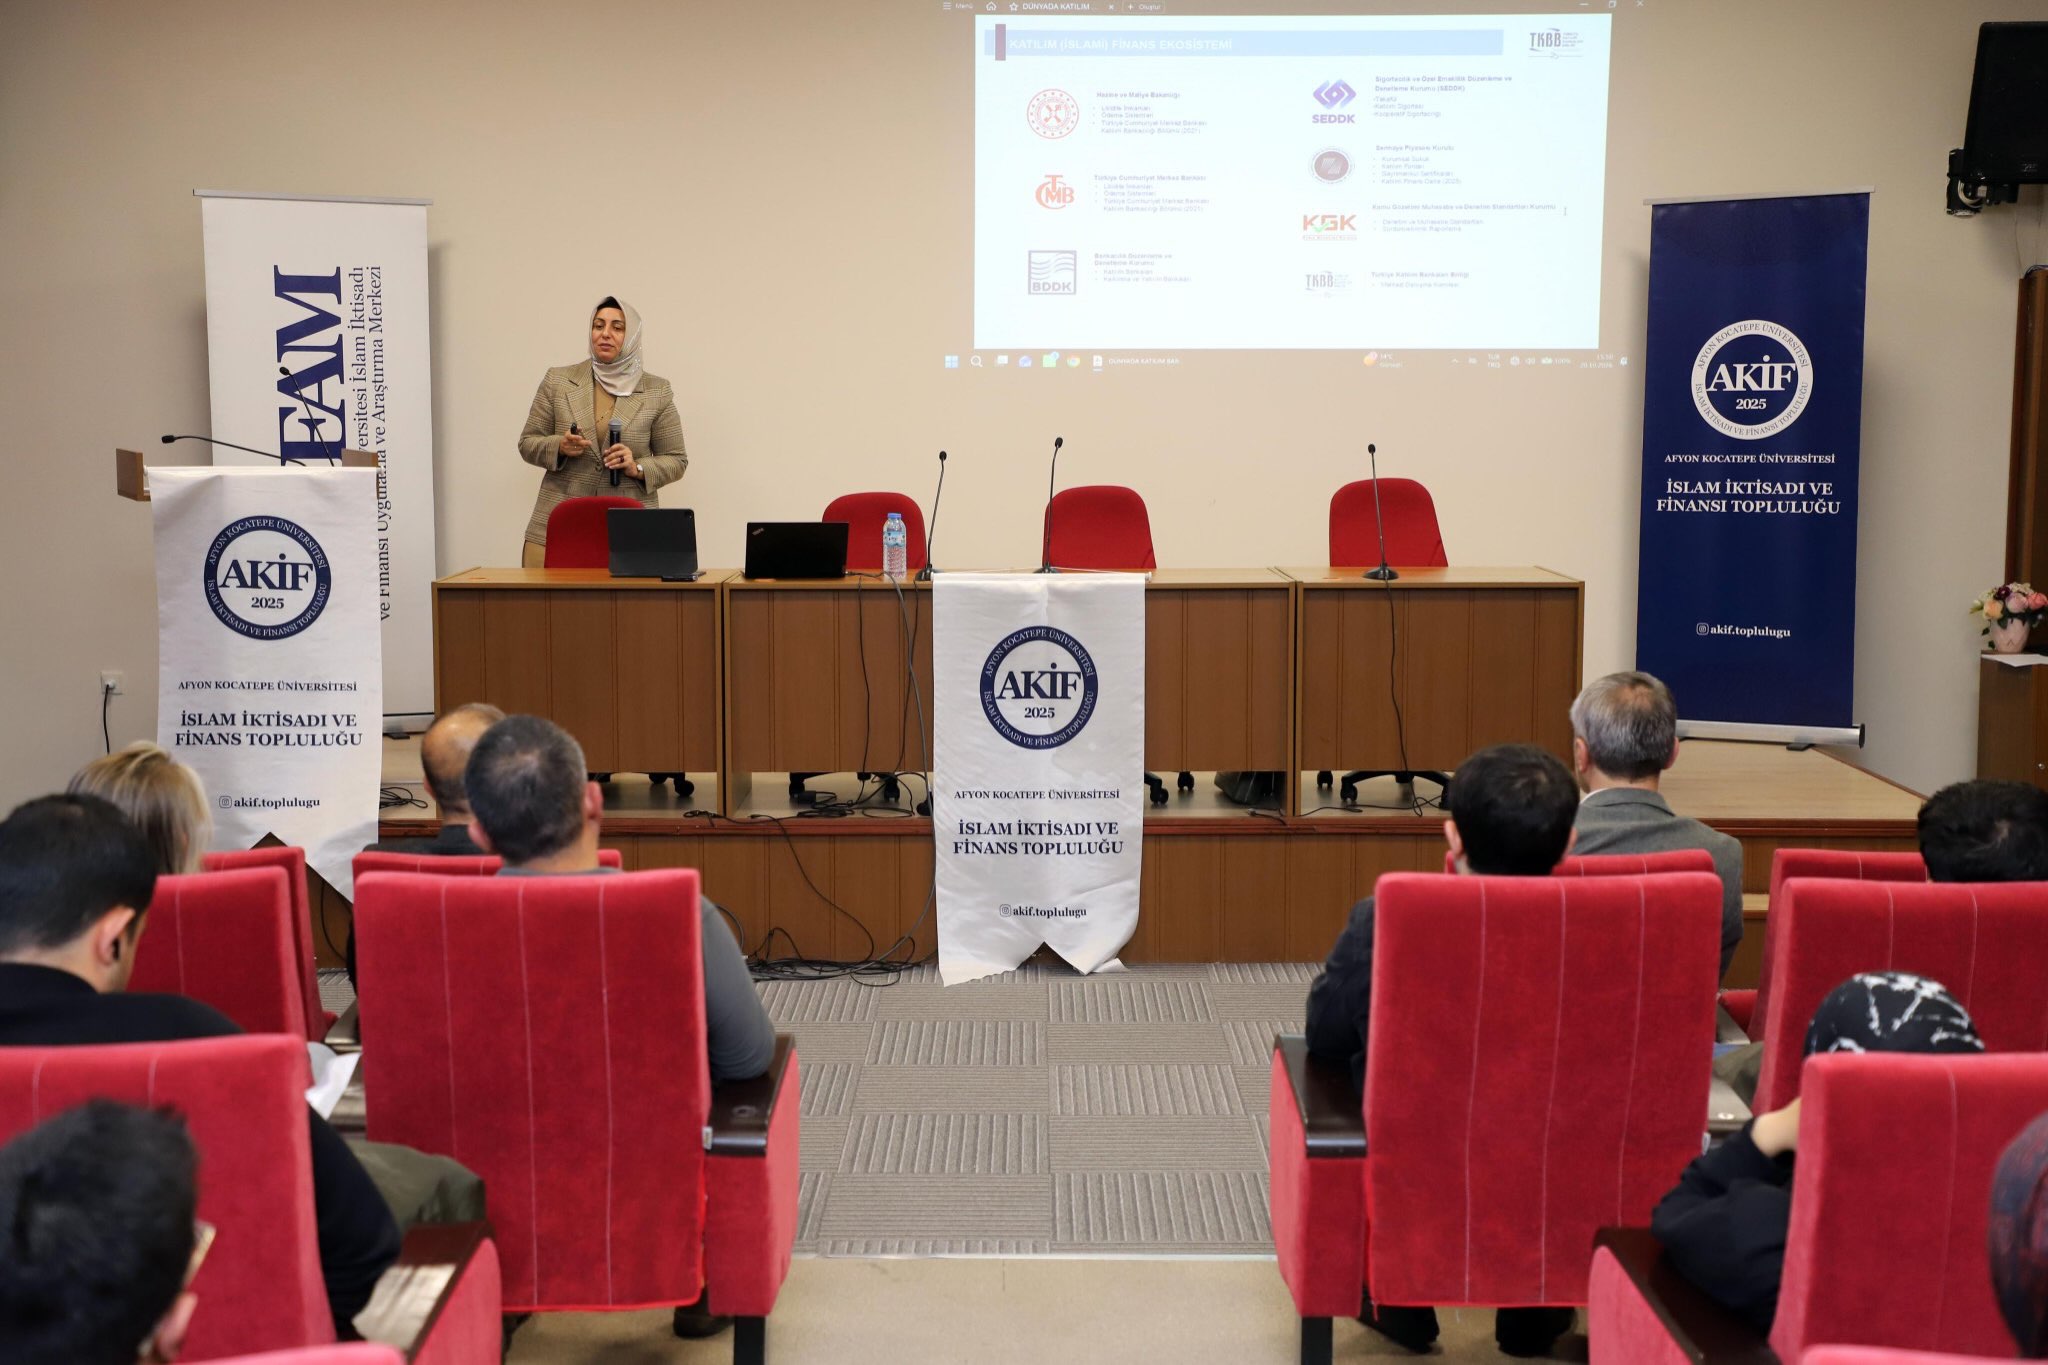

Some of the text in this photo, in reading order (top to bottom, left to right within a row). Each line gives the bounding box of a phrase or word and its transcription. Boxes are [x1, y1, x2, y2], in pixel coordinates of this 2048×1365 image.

[1022, 1, 1058, 10] DÜNYADA
[1010, 38, 1232, 51] KATILIM (İSLAMİ) FİNANS EKOSİSTEMİ
[1530, 32, 1561, 48] TKBB
[1312, 114, 1356, 124] SEDDK
[1032, 282, 1072, 292] BDDK
[1305, 274, 1334, 288] TKBB
[347, 266, 366, 330] İktisadı
[366, 266, 383, 332] Merkezi
[1698, 323, 1810, 370] AFYON KOCATEPE ÜNİVERSİTESİ
[349, 336, 367, 382] İslam
[369, 339, 388, 422] Araştırma
[1706, 354, 1796, 392] AKİF
[1695, 382, 1808, 436] İSLAM İKTİSADI VE FİNANSI TOPLULUĞU
[1736, 398, 1766, 410] 2025
[376, 426, 387, 444] ve
[1664, 452, 1836, 464] AFYON KOCATEPE ÜNİVERSİTESİ
[1666, 478, 1833, 495] İSLAM İKTİSADI VE
[1656, 496, 1840, 514] FİNANSI TOPLULUĞU
[209, 519, 328, 569] AFYON KOCATEPE ÜNİVERSİTESİ
[219, 553, 314, 591] AKİF
[208, 580, 328, 637] İSLAM İKTİSADI VE FİNANSI TOPLULUĞU
[251, 597, 284, 609] 2025
[380, 602, 391, 621] ve
[1710, 624, 1791, 638] akif.toplulugu
[986, 628, 1096, 678] AFYON KOCATEPE ÜNİVERSİTESİ
[178, 680, 358, 692] AFYON KOCATEPE ÜNİVERSİTESİ
[996, 662, 1082, 700] AKİF
[181, 710, 357, 728] İSLAM İKTİSADI VE
[984, 691, 1094, 746] İSLAM İKTİSADI VE FİNANSI TOPLULUĞU
[1024, 707, 1055, 718] 2025
[175, 728, 362, 747] FİNANS TOPLULUĞU
[234, 796, 320, 809] akif.toplulugu
[954, 788, 1120, 800] AFYON KOCATEPE ÜNİVERSİTESİ
[958, 818, 1119, 836] İSLAM İKTİSADI VE
[953, 838, 1124, 855] FİNANS TOPLULUĞU
[1012, 906, 1087, 918] akif.toplulugu
